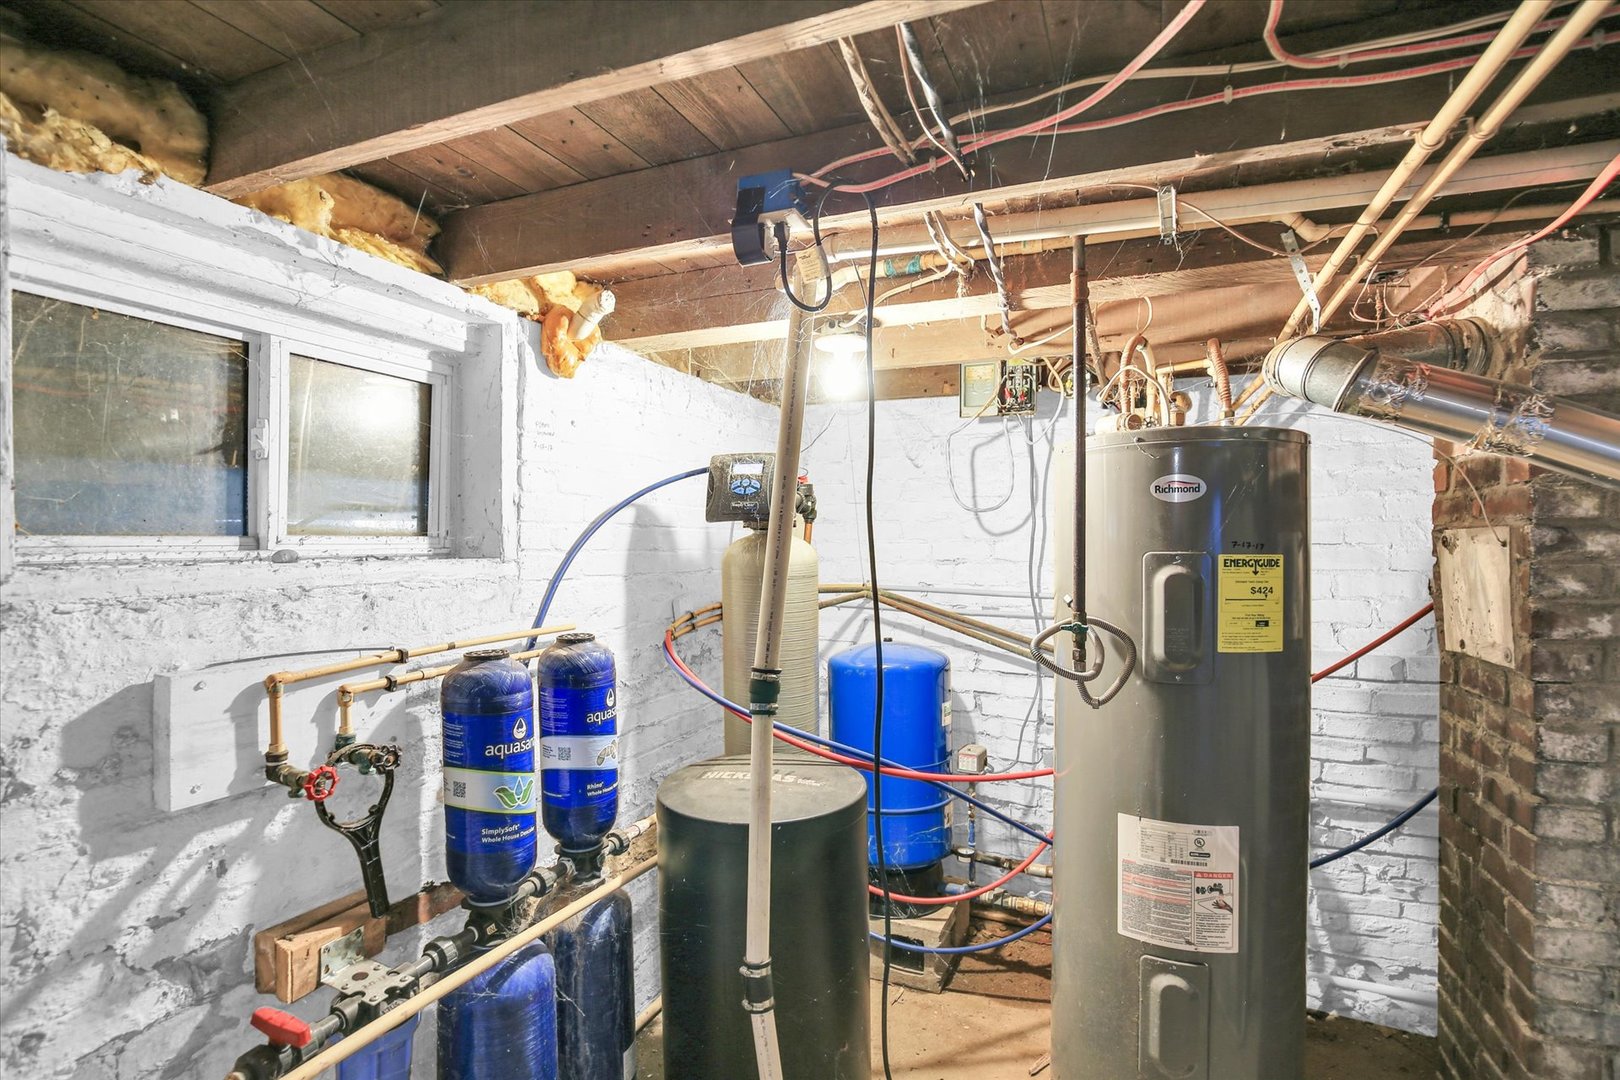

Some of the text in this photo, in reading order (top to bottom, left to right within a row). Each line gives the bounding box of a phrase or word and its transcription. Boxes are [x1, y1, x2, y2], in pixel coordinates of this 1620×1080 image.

[1154, 482, 1201, 494] Richmond
[1223, 558, 1281, 568] ENERGYGUIDE
[481, 836, 502, 844] Whole
[502, 832, 520, 842] House
